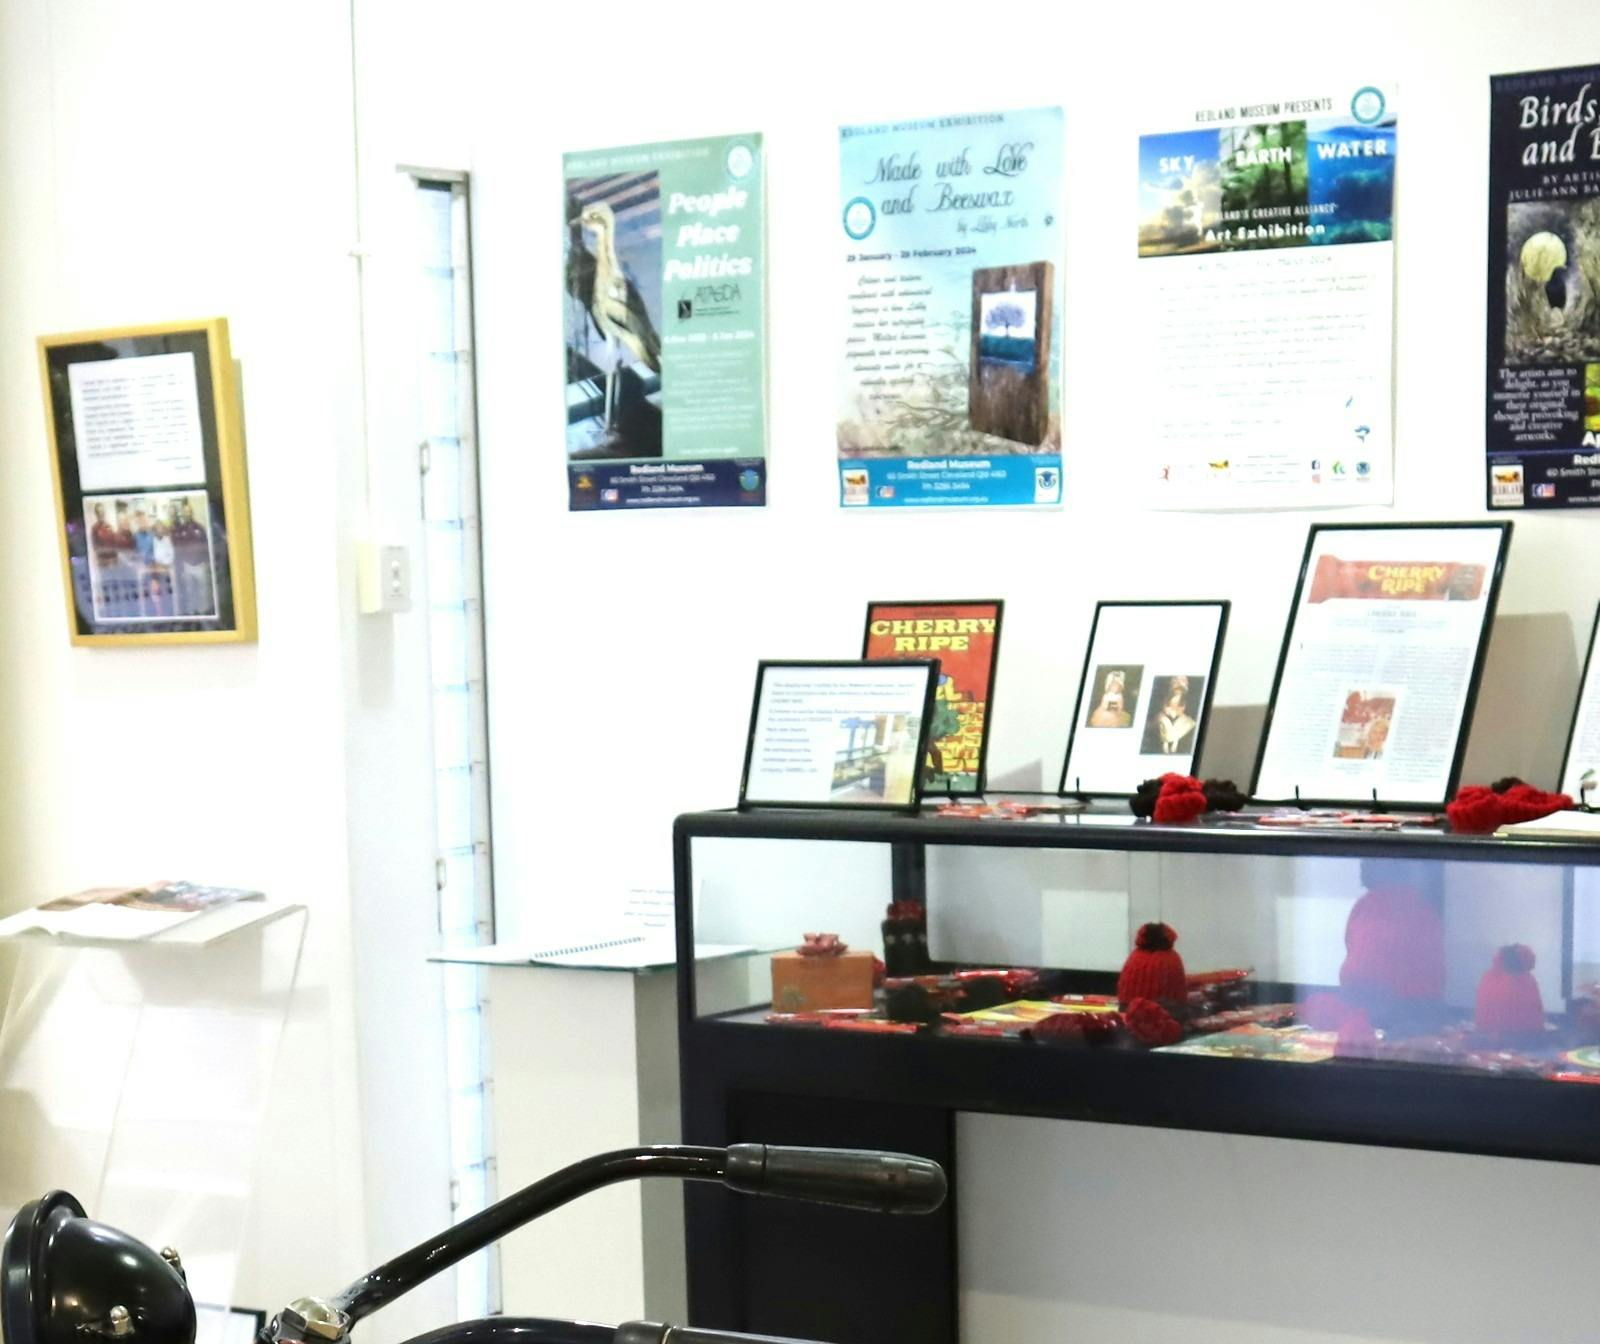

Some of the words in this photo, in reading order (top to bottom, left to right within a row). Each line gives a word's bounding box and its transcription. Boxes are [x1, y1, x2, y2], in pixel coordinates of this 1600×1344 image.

[1195, 105, 1236, 122] REDLAND
[1240, 102, 1281, 118] MUSEUM
[1284, 97, 1333, 115] PRESENTS
[1317, 138, 1388, 160] WATER
[1522, 122, 1584, 166] and
[863, 150, 924, 185] Made
[935, 146, 972, 179] with
[1159, 155, 1196, 174] SKY
[1236, 147, 1292, 167] EARTH
[1543, 173, 1559, 186] BY
[668, 185, 749, 218] People
[880, 184, 920, 216] and
[924, 182, 1015, 213] Beeswax
[1252, 205, 1292, 219] CREATIVE
[675, 222, 741, 248] Place
[1205, 228, 1232, 242] Art
[1237, 221, 1326, 241] Exhibition
[663, 254, 753, 282] Politics
[1560, 467, 1586, 477] Smith
[1368, 564, 1447, 583] CHERRY
[1381, 578, 1426, 595] RIPE
[869, 618, 997, 635] CHERRY
[894, 636, 970, 652] RIPE
